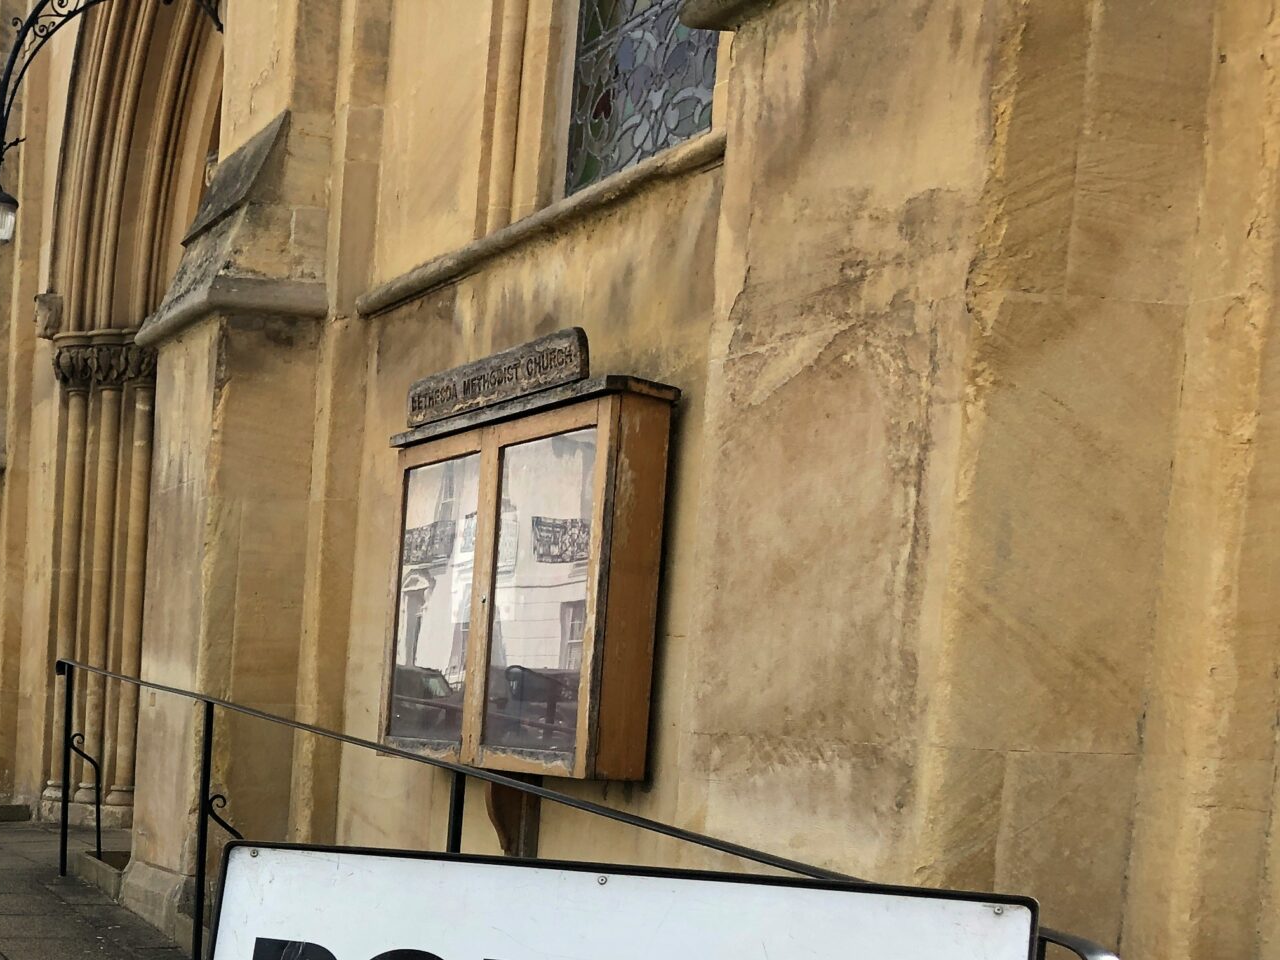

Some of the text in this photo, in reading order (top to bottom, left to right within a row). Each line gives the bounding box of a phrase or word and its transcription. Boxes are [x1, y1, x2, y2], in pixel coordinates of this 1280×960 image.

[411, 346, 573, 412] BETHESDA METHODIST CHURCH
